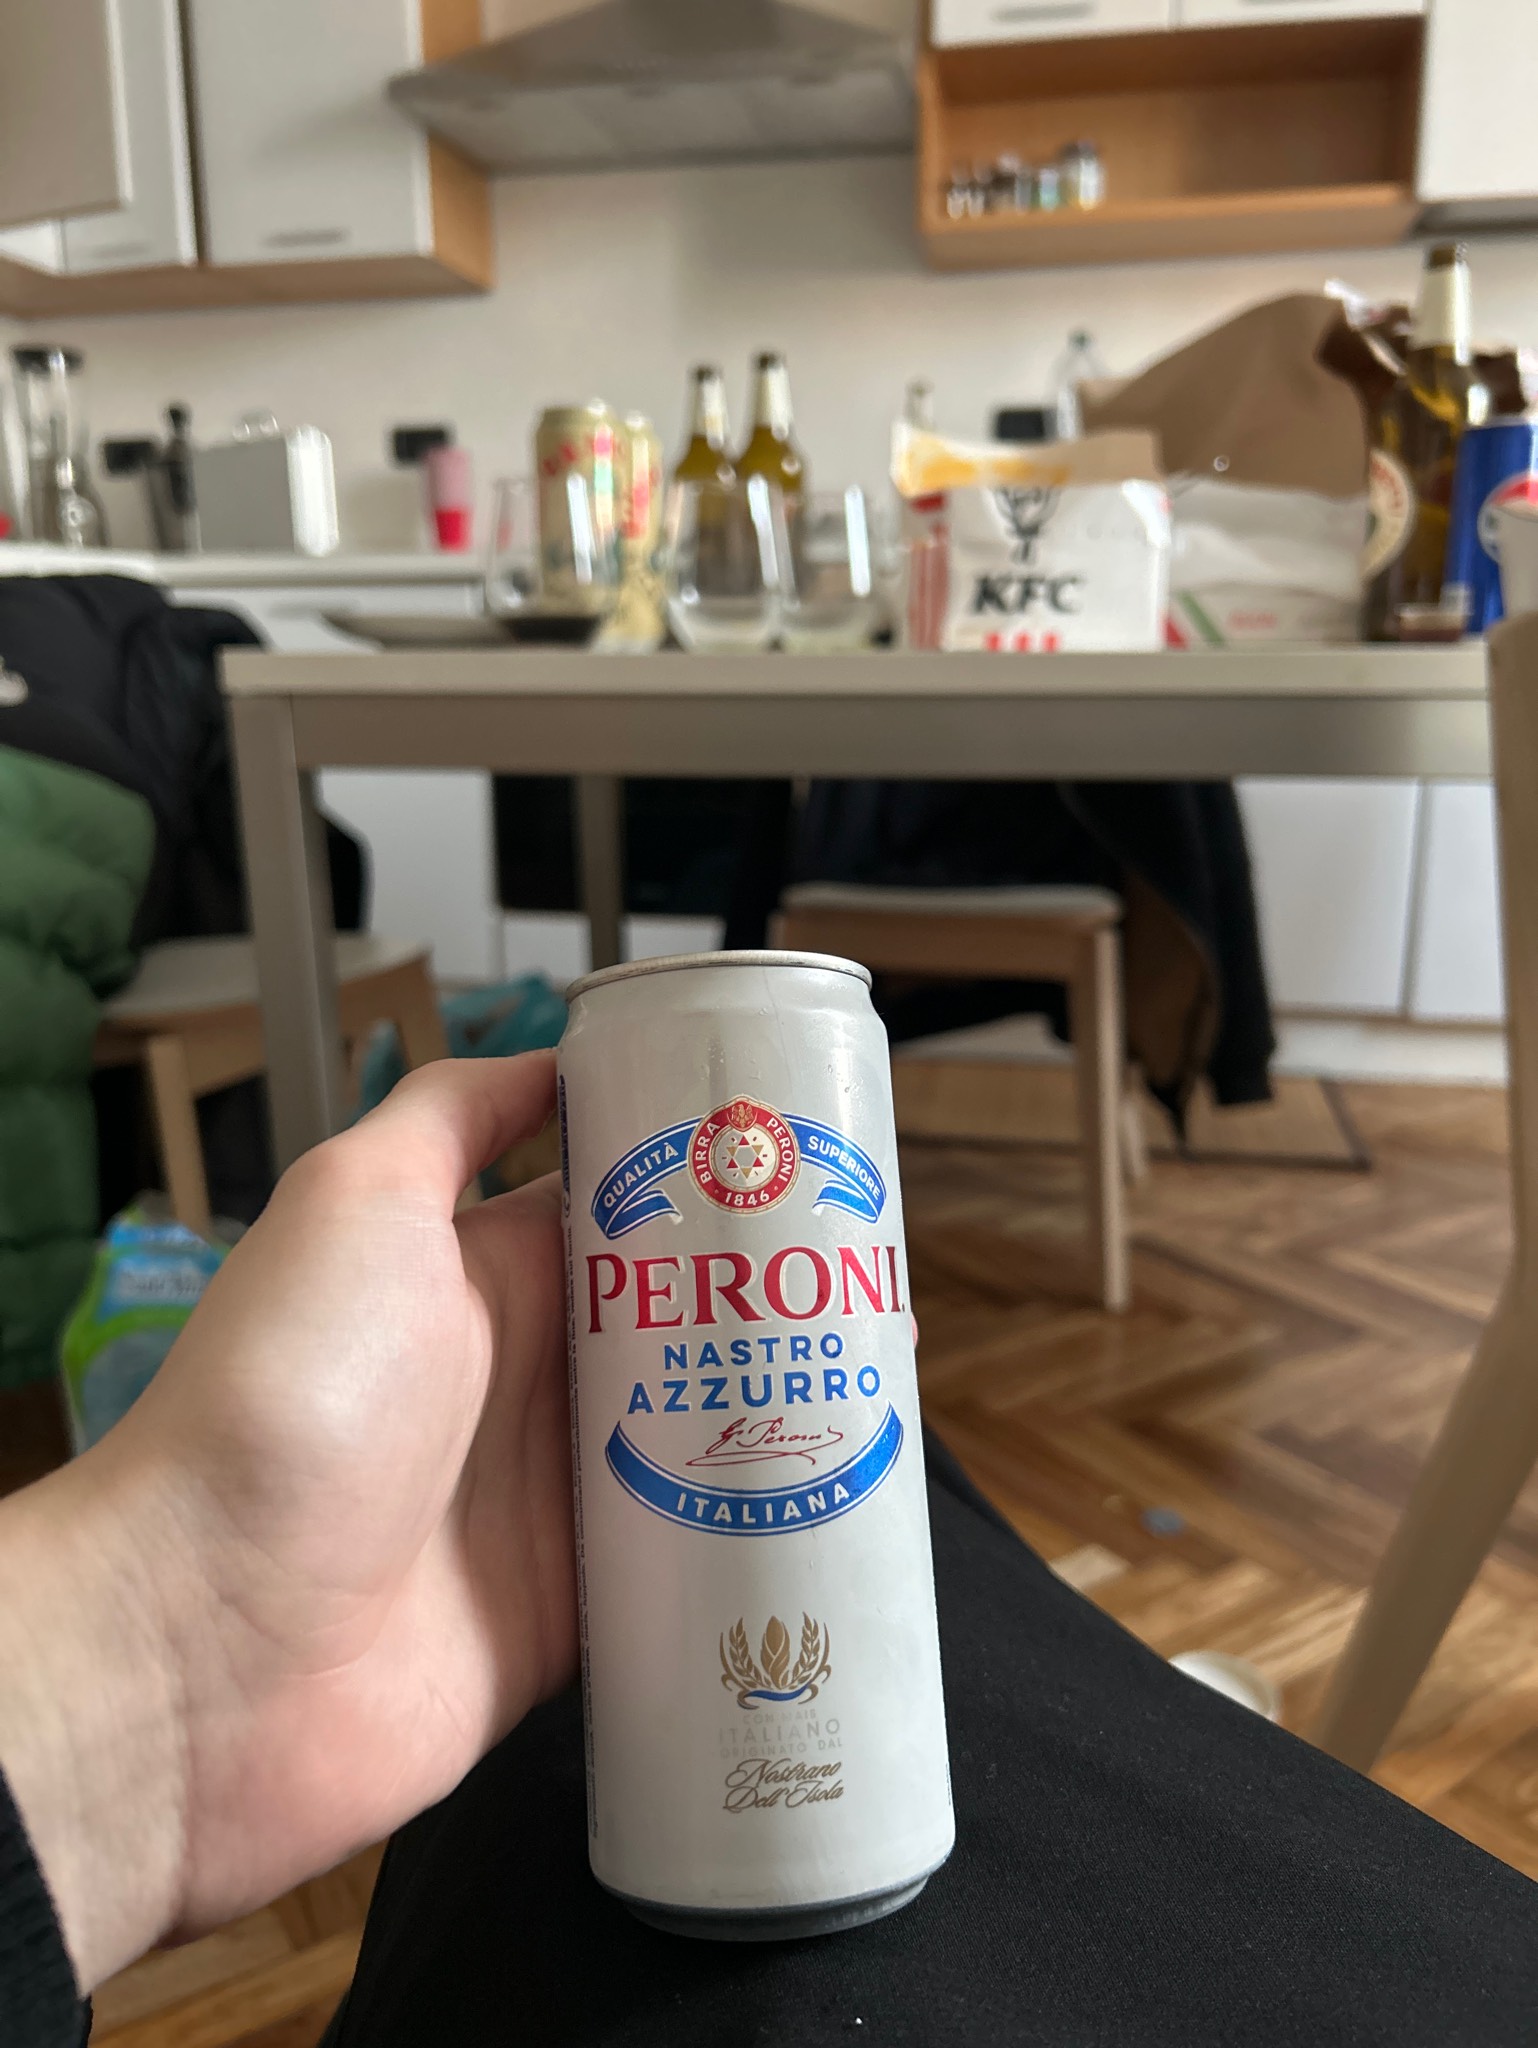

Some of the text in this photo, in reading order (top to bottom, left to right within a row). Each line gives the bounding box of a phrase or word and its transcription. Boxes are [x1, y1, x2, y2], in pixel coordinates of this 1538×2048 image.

[973, 574, 1084, 616] KFC
[695, 1117, 794, 1184] BIRRA PERONI
[808, 1136, 881, 1201] SUPERIORE
[603, 1141, 679, 1208] QUALITÀ
[724, 1190, 770, 1207] 1846
[586, 1245, 900, 1334] PERONI
[664, 1333, 844, 1370] NASTRO
[627, 1364, 881, 1414] AZZURRO
[677, 1482, 850, 1524] ITALIANA
[719, 1719, 840, 1745] ITALIANO
[743, 1713, 774, 1725] CON
[818, 1737, 843, 1750] DAL
[725, 1758, 842, 1788] Nostrano
